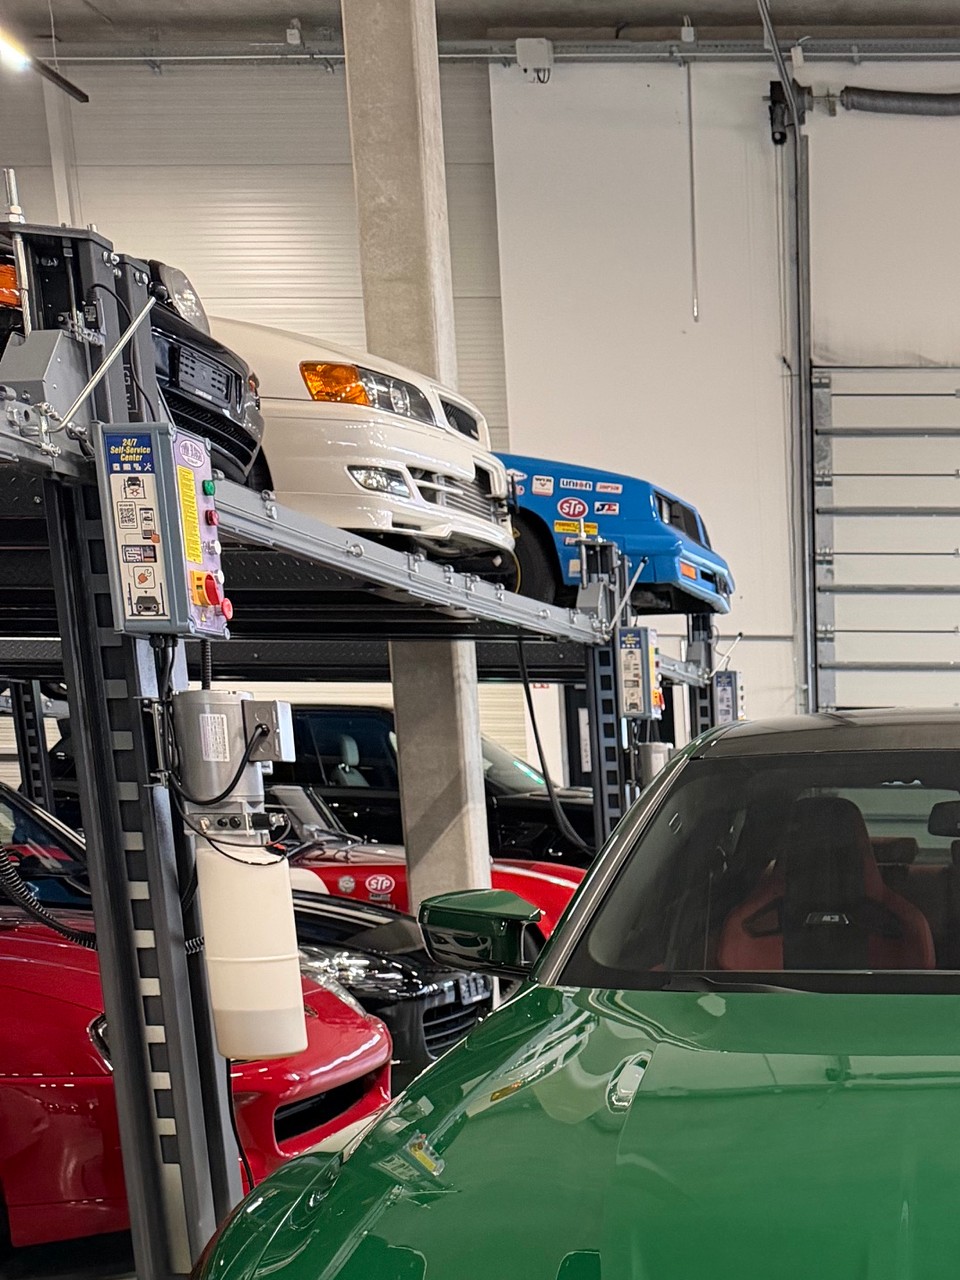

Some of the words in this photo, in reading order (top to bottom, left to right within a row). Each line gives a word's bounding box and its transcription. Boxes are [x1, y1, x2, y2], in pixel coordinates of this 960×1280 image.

[122, 438, 138, 446] 24/7
[110, 446, 151, 454] Self-Service
[120, 453, 143, 462] Center
[562, 500, 584, 515] STP
[370, 876, 391, 890] STP
